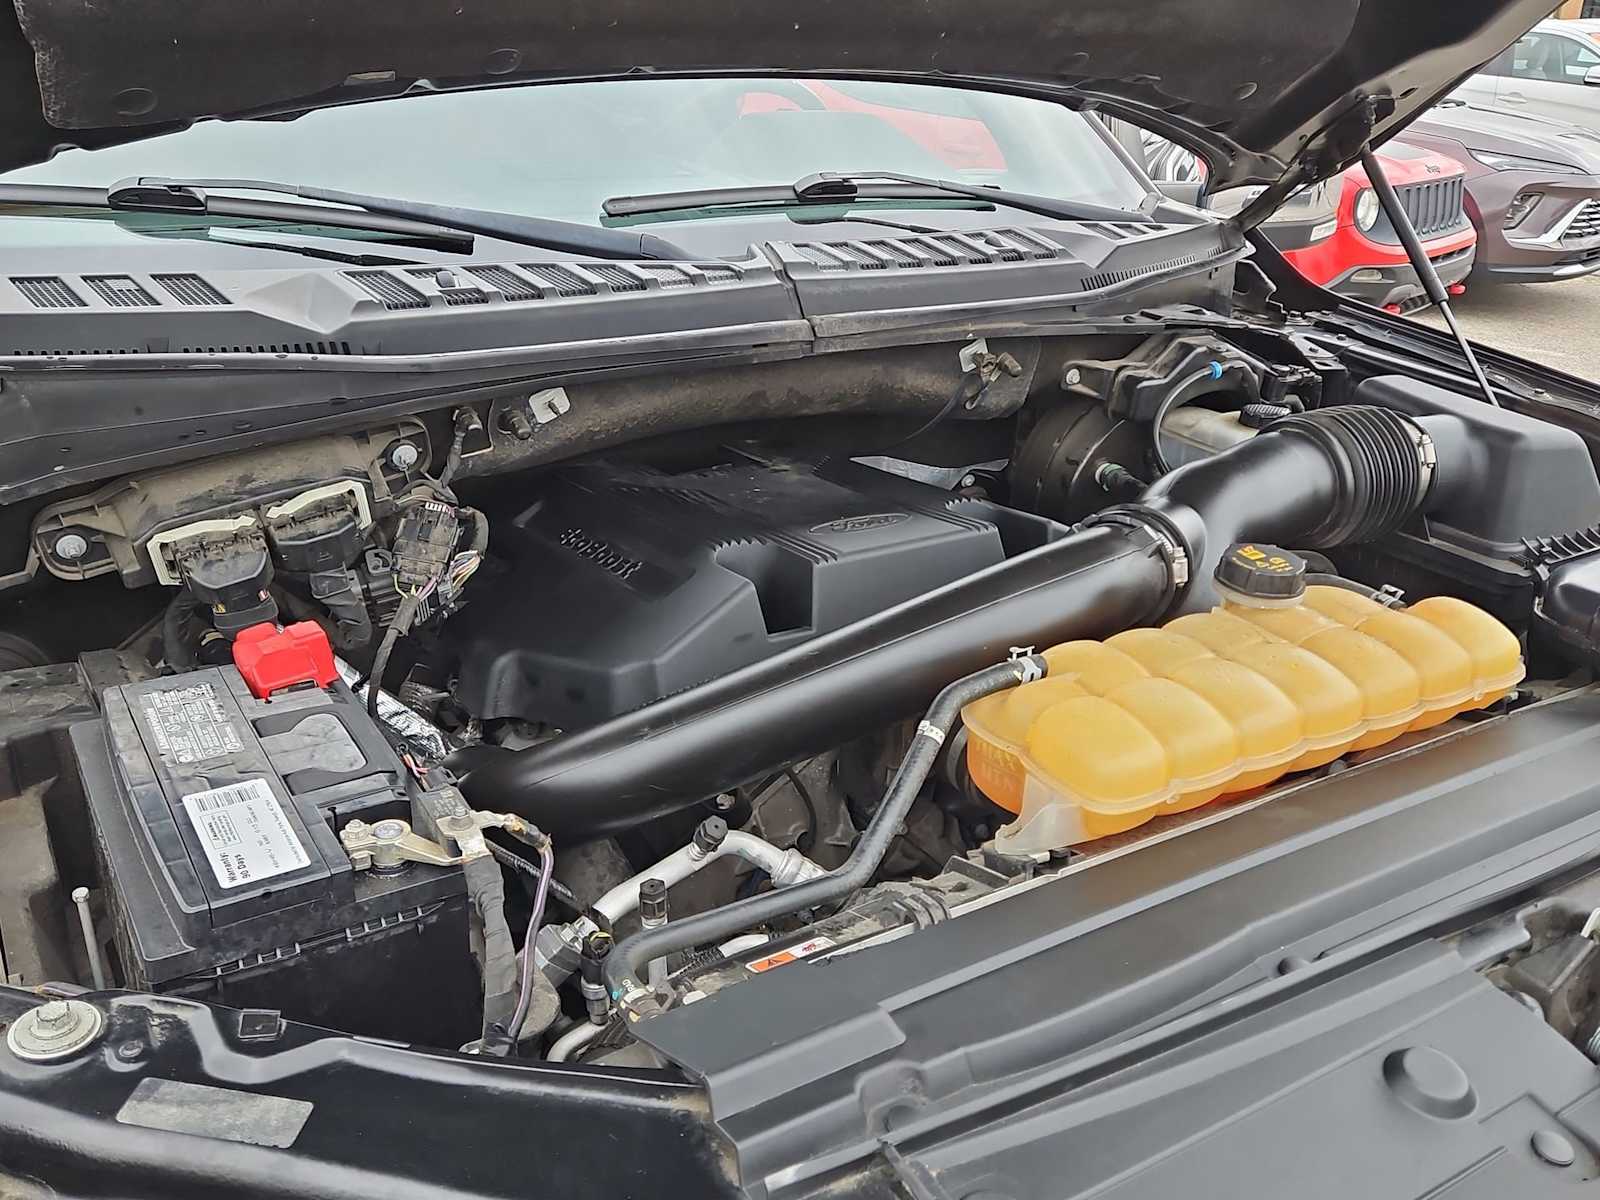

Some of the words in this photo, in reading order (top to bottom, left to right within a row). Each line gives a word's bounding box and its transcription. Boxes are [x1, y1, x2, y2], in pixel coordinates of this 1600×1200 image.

[219, 852, 237, 883] Warranty:
[234, 854, 247, 870] Days
[239, 870, 251, 879] 90
